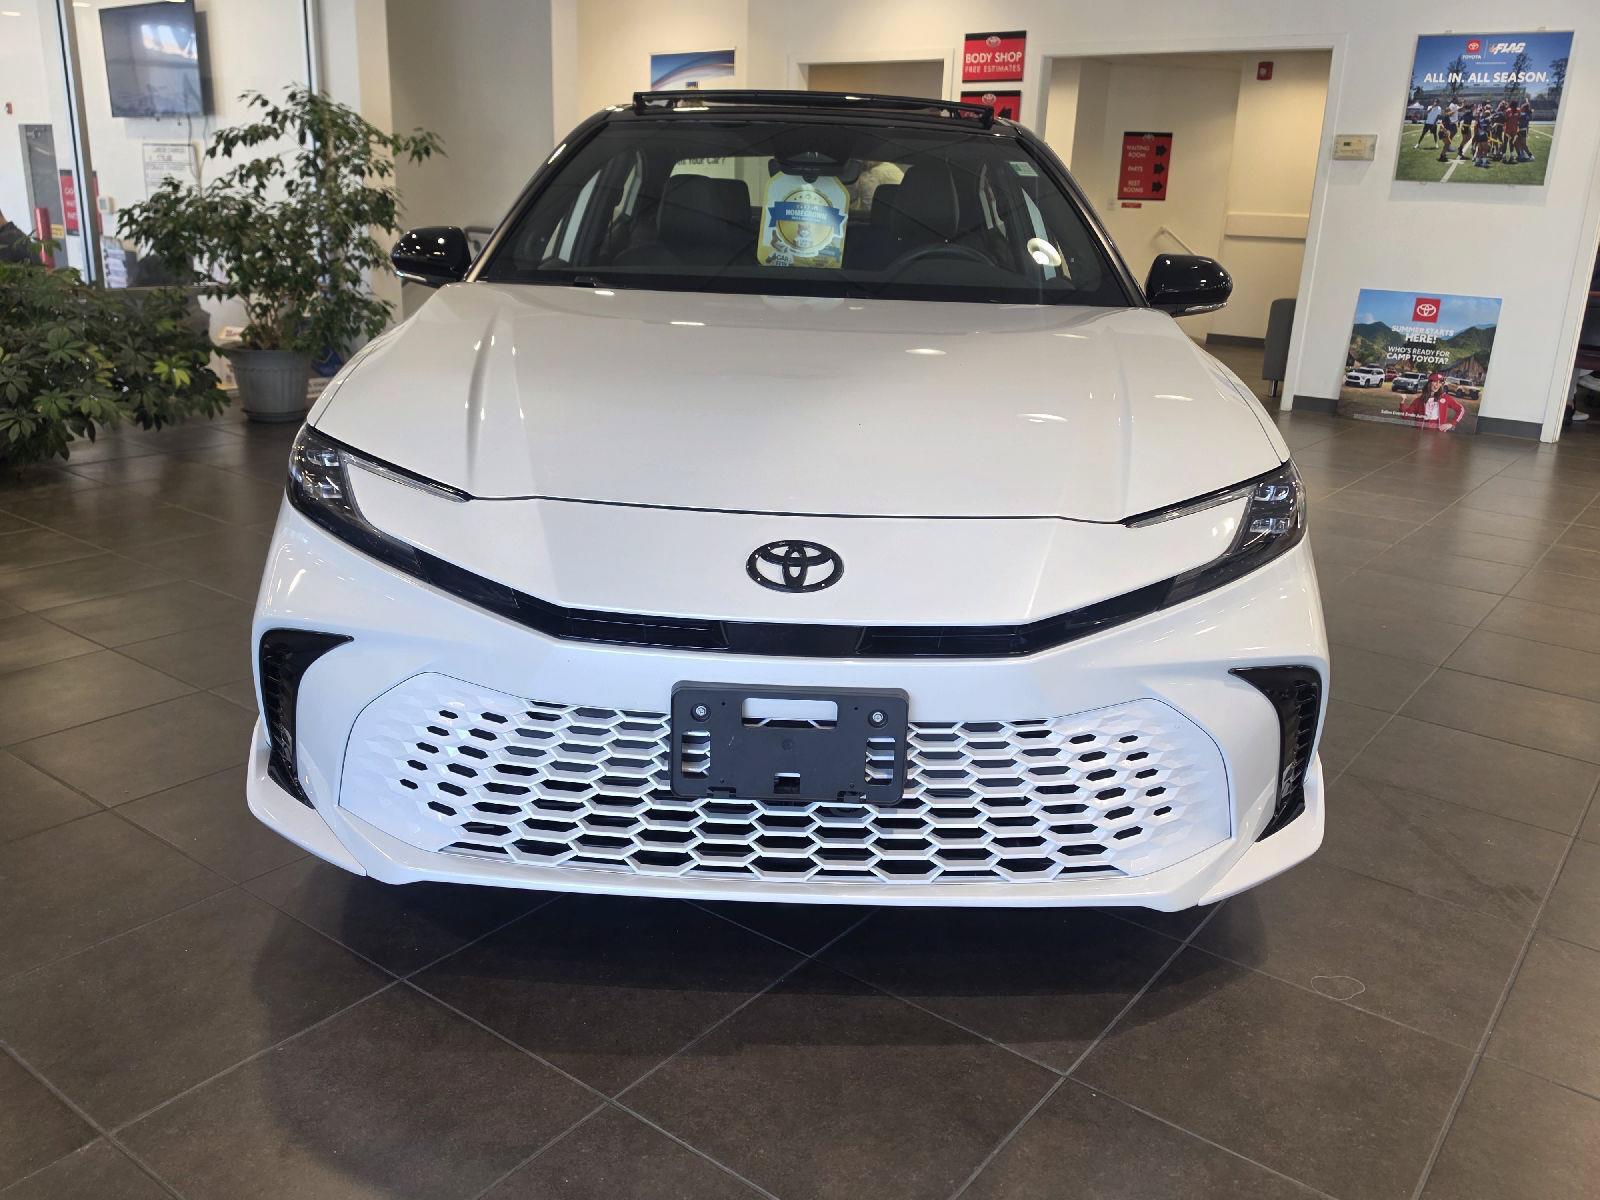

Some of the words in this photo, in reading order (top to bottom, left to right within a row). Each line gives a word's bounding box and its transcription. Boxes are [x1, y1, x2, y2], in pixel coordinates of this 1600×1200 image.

[1493, 42, 1526, 55] FLAG
[965, 52, 992, 64] BODY
[994, 51, 1022, 63] SHOP
[964, 65, 981, 74] FREE
[983, 64, 1021, 73] ESTIMATES
[1423, 72, 1446, 83] ALL
[1447, 72, 1465, 83] IN.
[1467, 72, 1492, 83] ALL
[1492, 71, 1549, 83] SEASON.
[785, 209, 828, 220] HOMEGROWN
[1391, 325, 1425, 334] SUMMER
[1425, 327, 1455, 337] STARTS
[1405, 333, 1437, 344] HERE!
[1388, 345, 1411, 354] WHO'S
[1412, 347, 1435, 355] READY
[1435, 350, 1451, 358] FOR
[1386, 352, 1411, 361] CAMP
[1412, 354, 1449, 364] TOYOTA?
